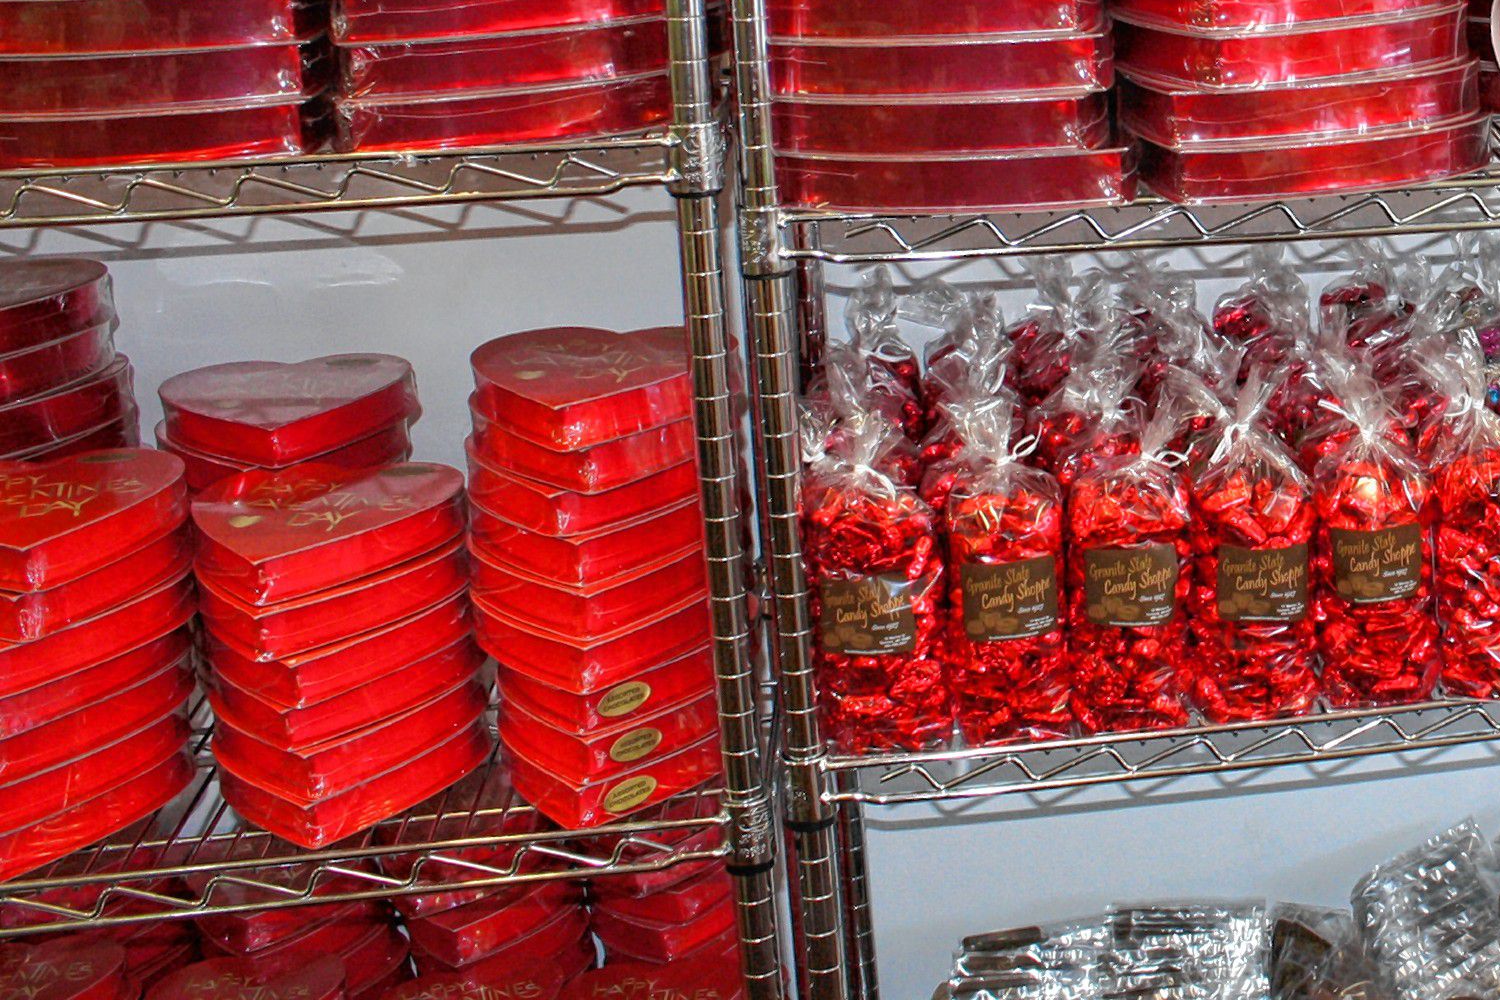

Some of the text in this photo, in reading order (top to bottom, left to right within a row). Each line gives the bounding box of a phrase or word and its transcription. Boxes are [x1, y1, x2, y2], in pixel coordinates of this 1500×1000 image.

[19, 492, 99, 518] DAY
[1336, 531, 1398, 558] Granite State
[1089, 553, 1154, 581] Granite State
[1222, 551, 1285, 579] Granite State
[1349, 542, 1417, 578] Candy Shoppe
[966, 565, 1031, 597] Granite State
[981, 575, 1051, 613] Candy Shoppe
[1104, 566, 1173, 601] Candy Shoppe
[1235, 564, 1305, 597] Candy Shoppe
[836, 602, 868, 629] Candy
